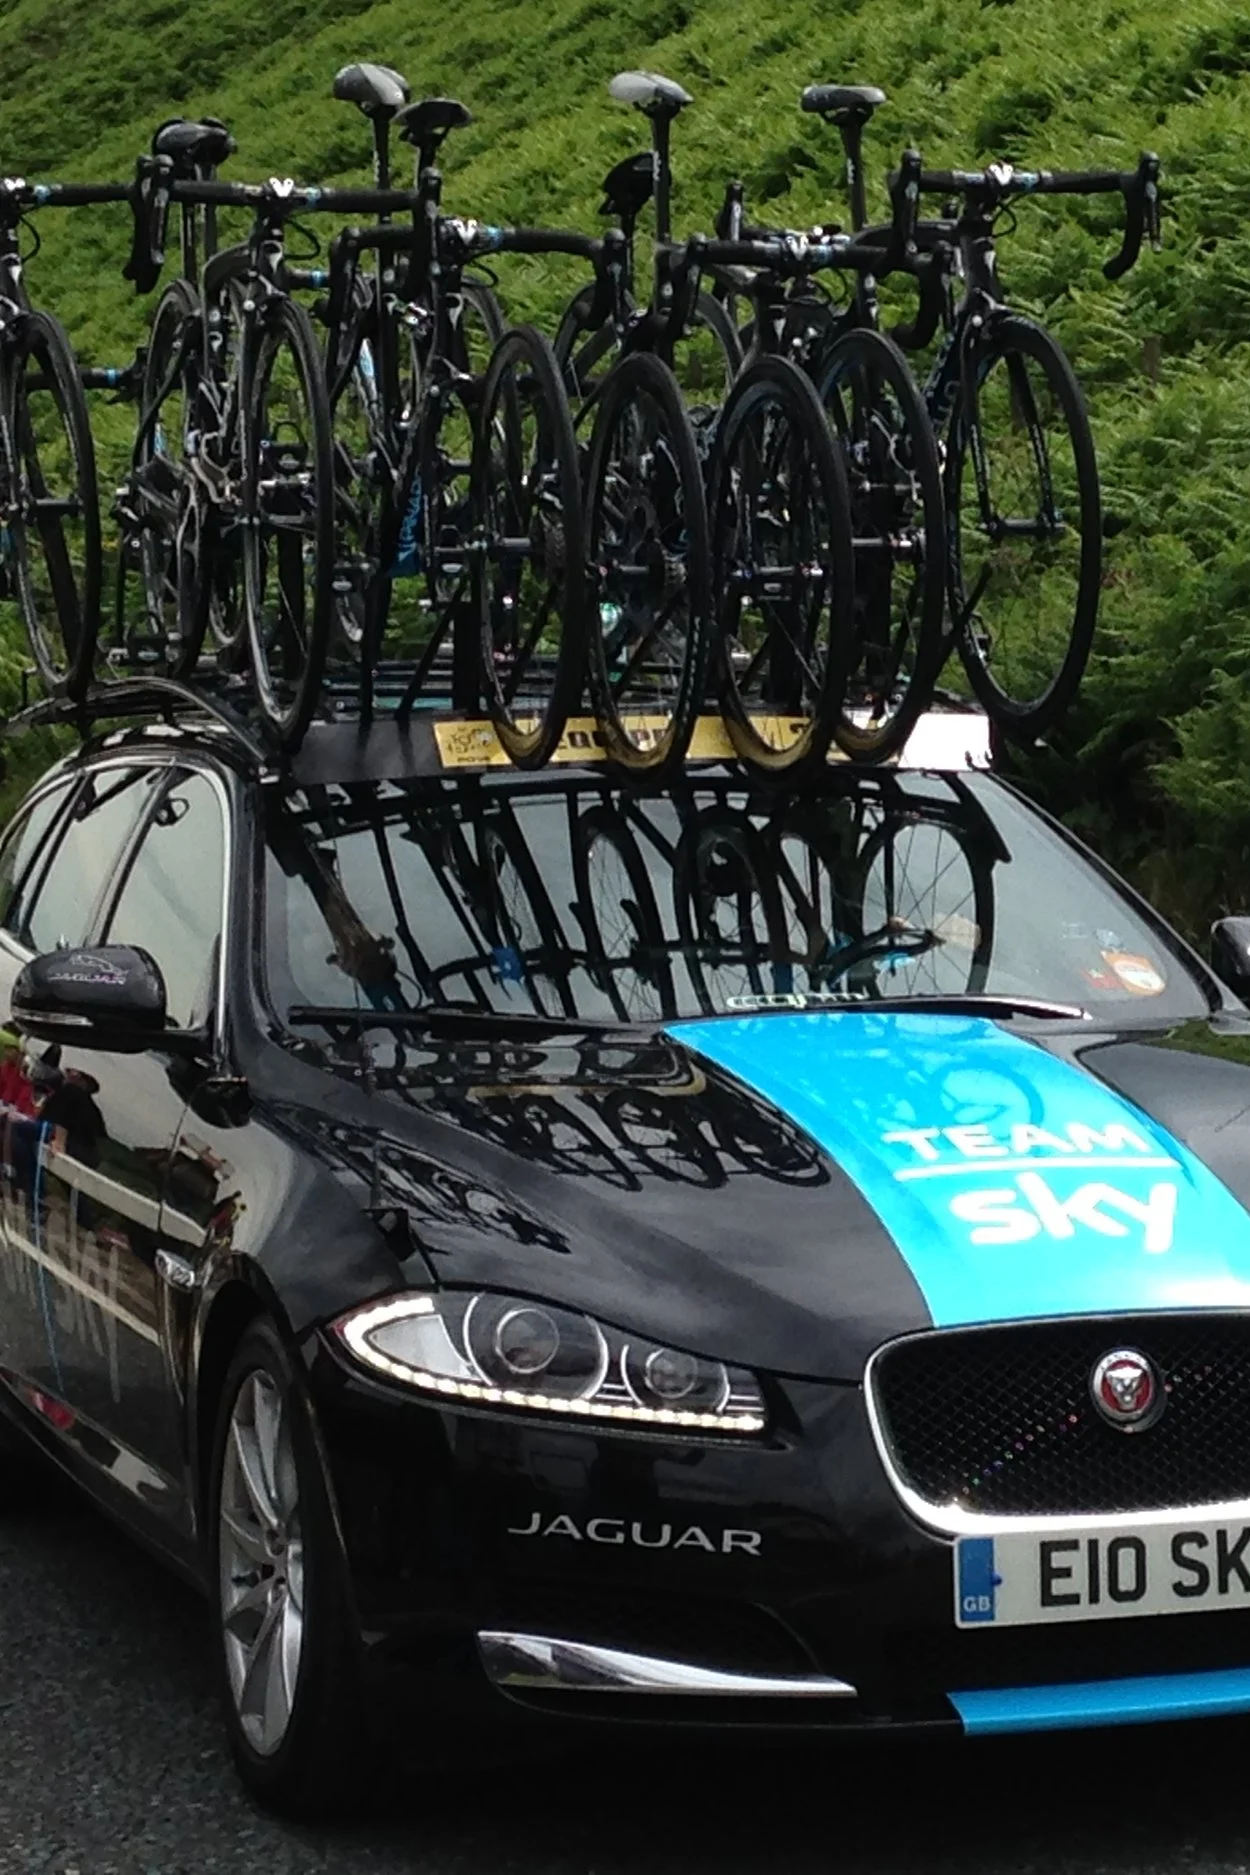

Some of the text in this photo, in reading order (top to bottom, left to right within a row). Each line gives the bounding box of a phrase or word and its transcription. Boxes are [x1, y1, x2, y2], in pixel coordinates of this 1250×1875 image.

[881, 1121, 1152, 1161] TEAM
[949, 1171, 1178, 1254] sky
[507, 1511, 762, 1556] JAGUAR
[1039, 1536, 1148, 1608] E10
[963, 1596, 991, 1612] GB
